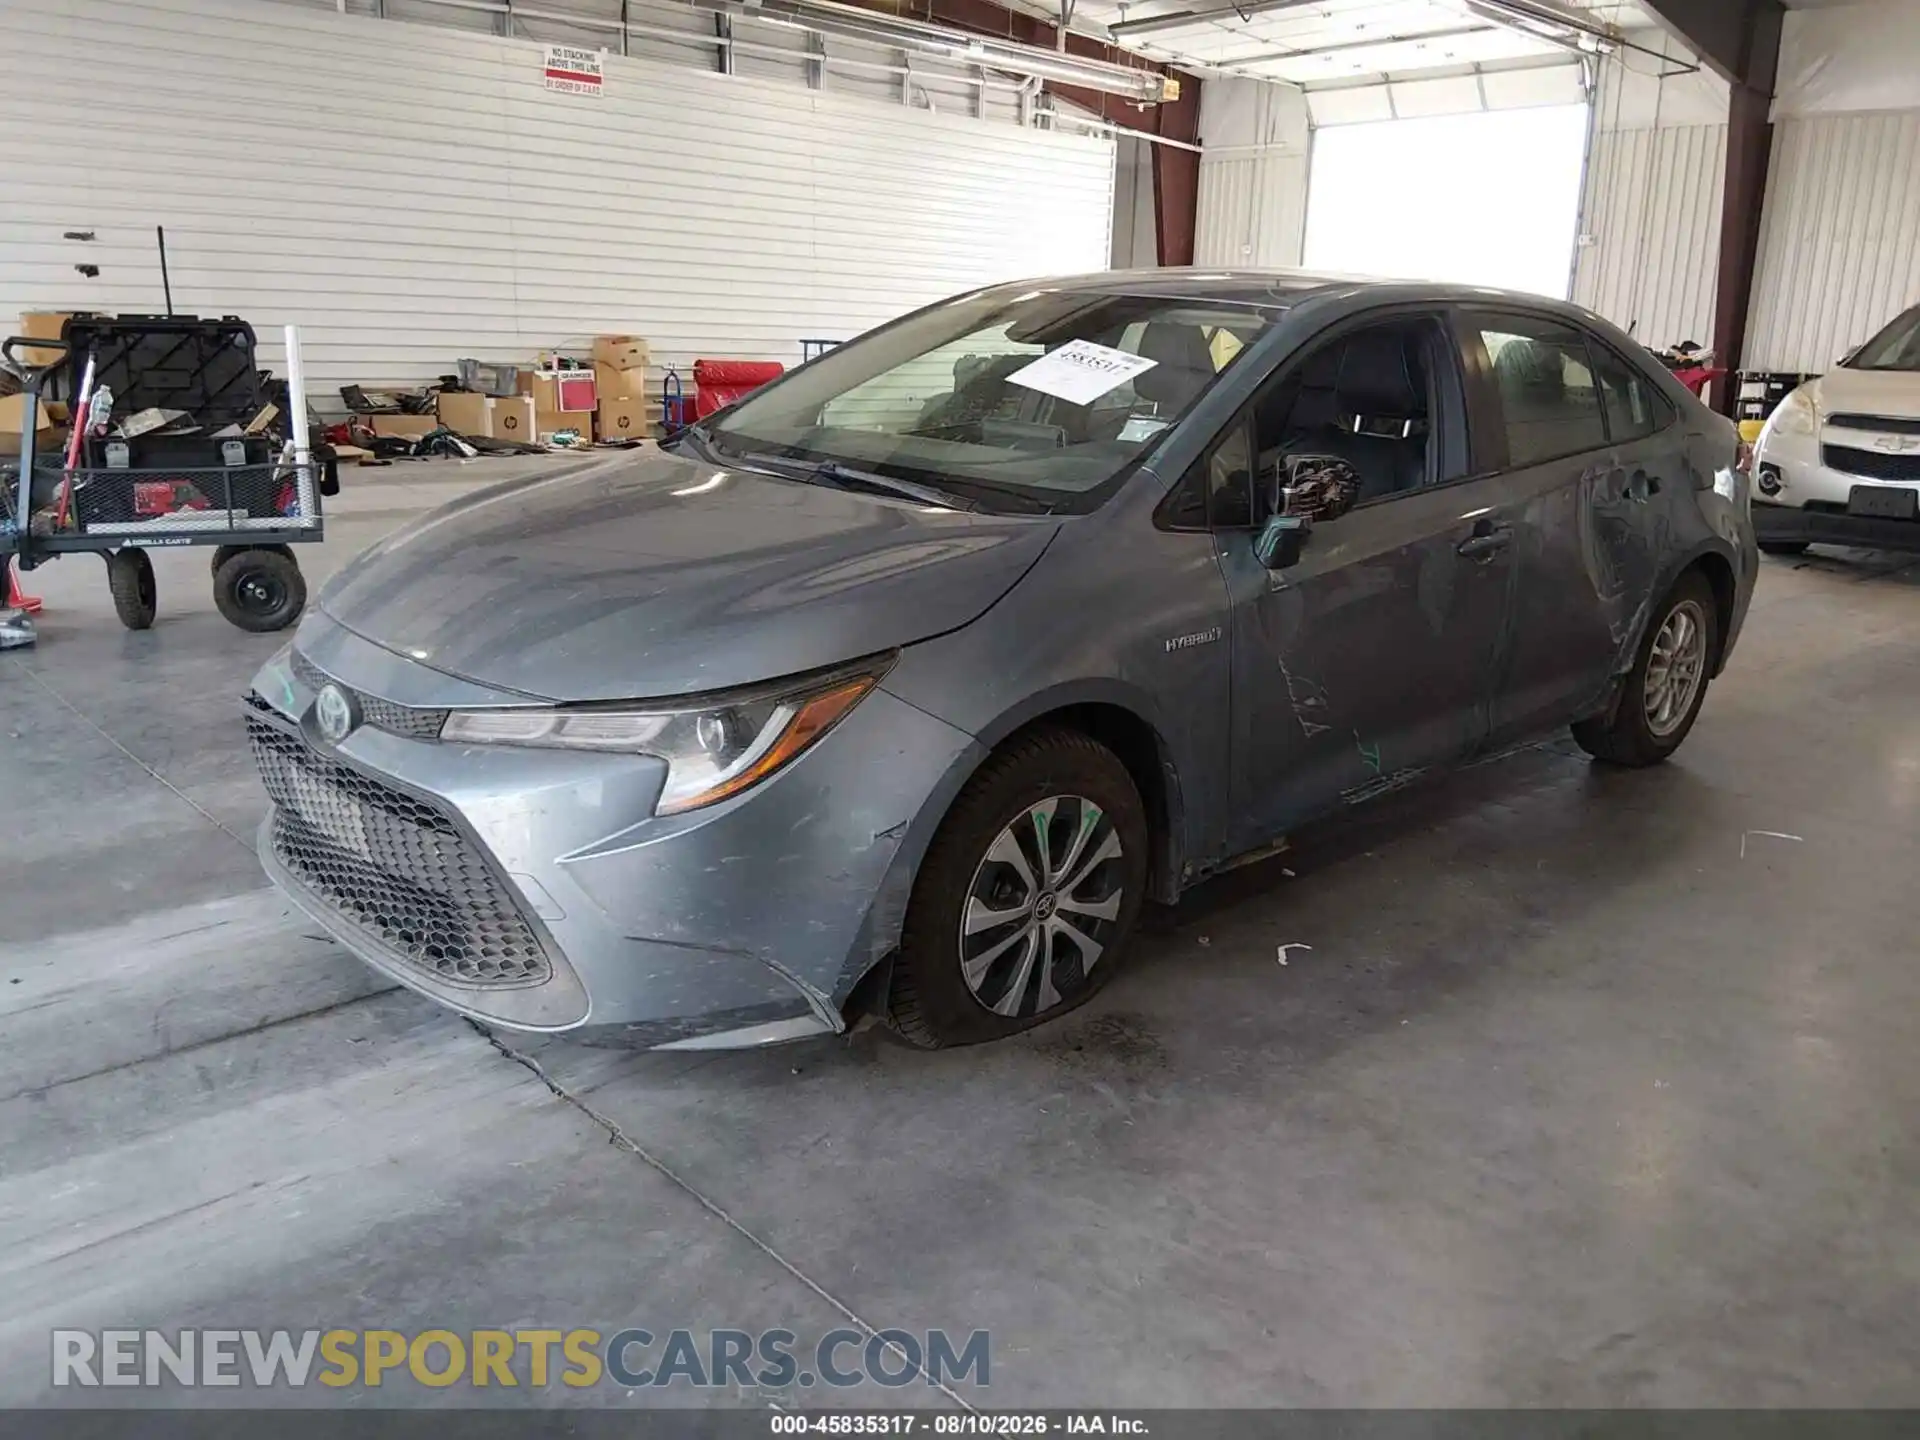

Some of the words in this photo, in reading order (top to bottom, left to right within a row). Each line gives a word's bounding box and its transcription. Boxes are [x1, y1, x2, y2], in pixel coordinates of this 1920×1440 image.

[552, 48, 561, 57] NO
[563, 49, 595, 61] STACKING
[548, 56, 568, 69] ABOVE
[570, 60, 584, 71] THIS
[586, 63, 600, 73] LINE
[1165, 627, 1222, 652] HYBRID
